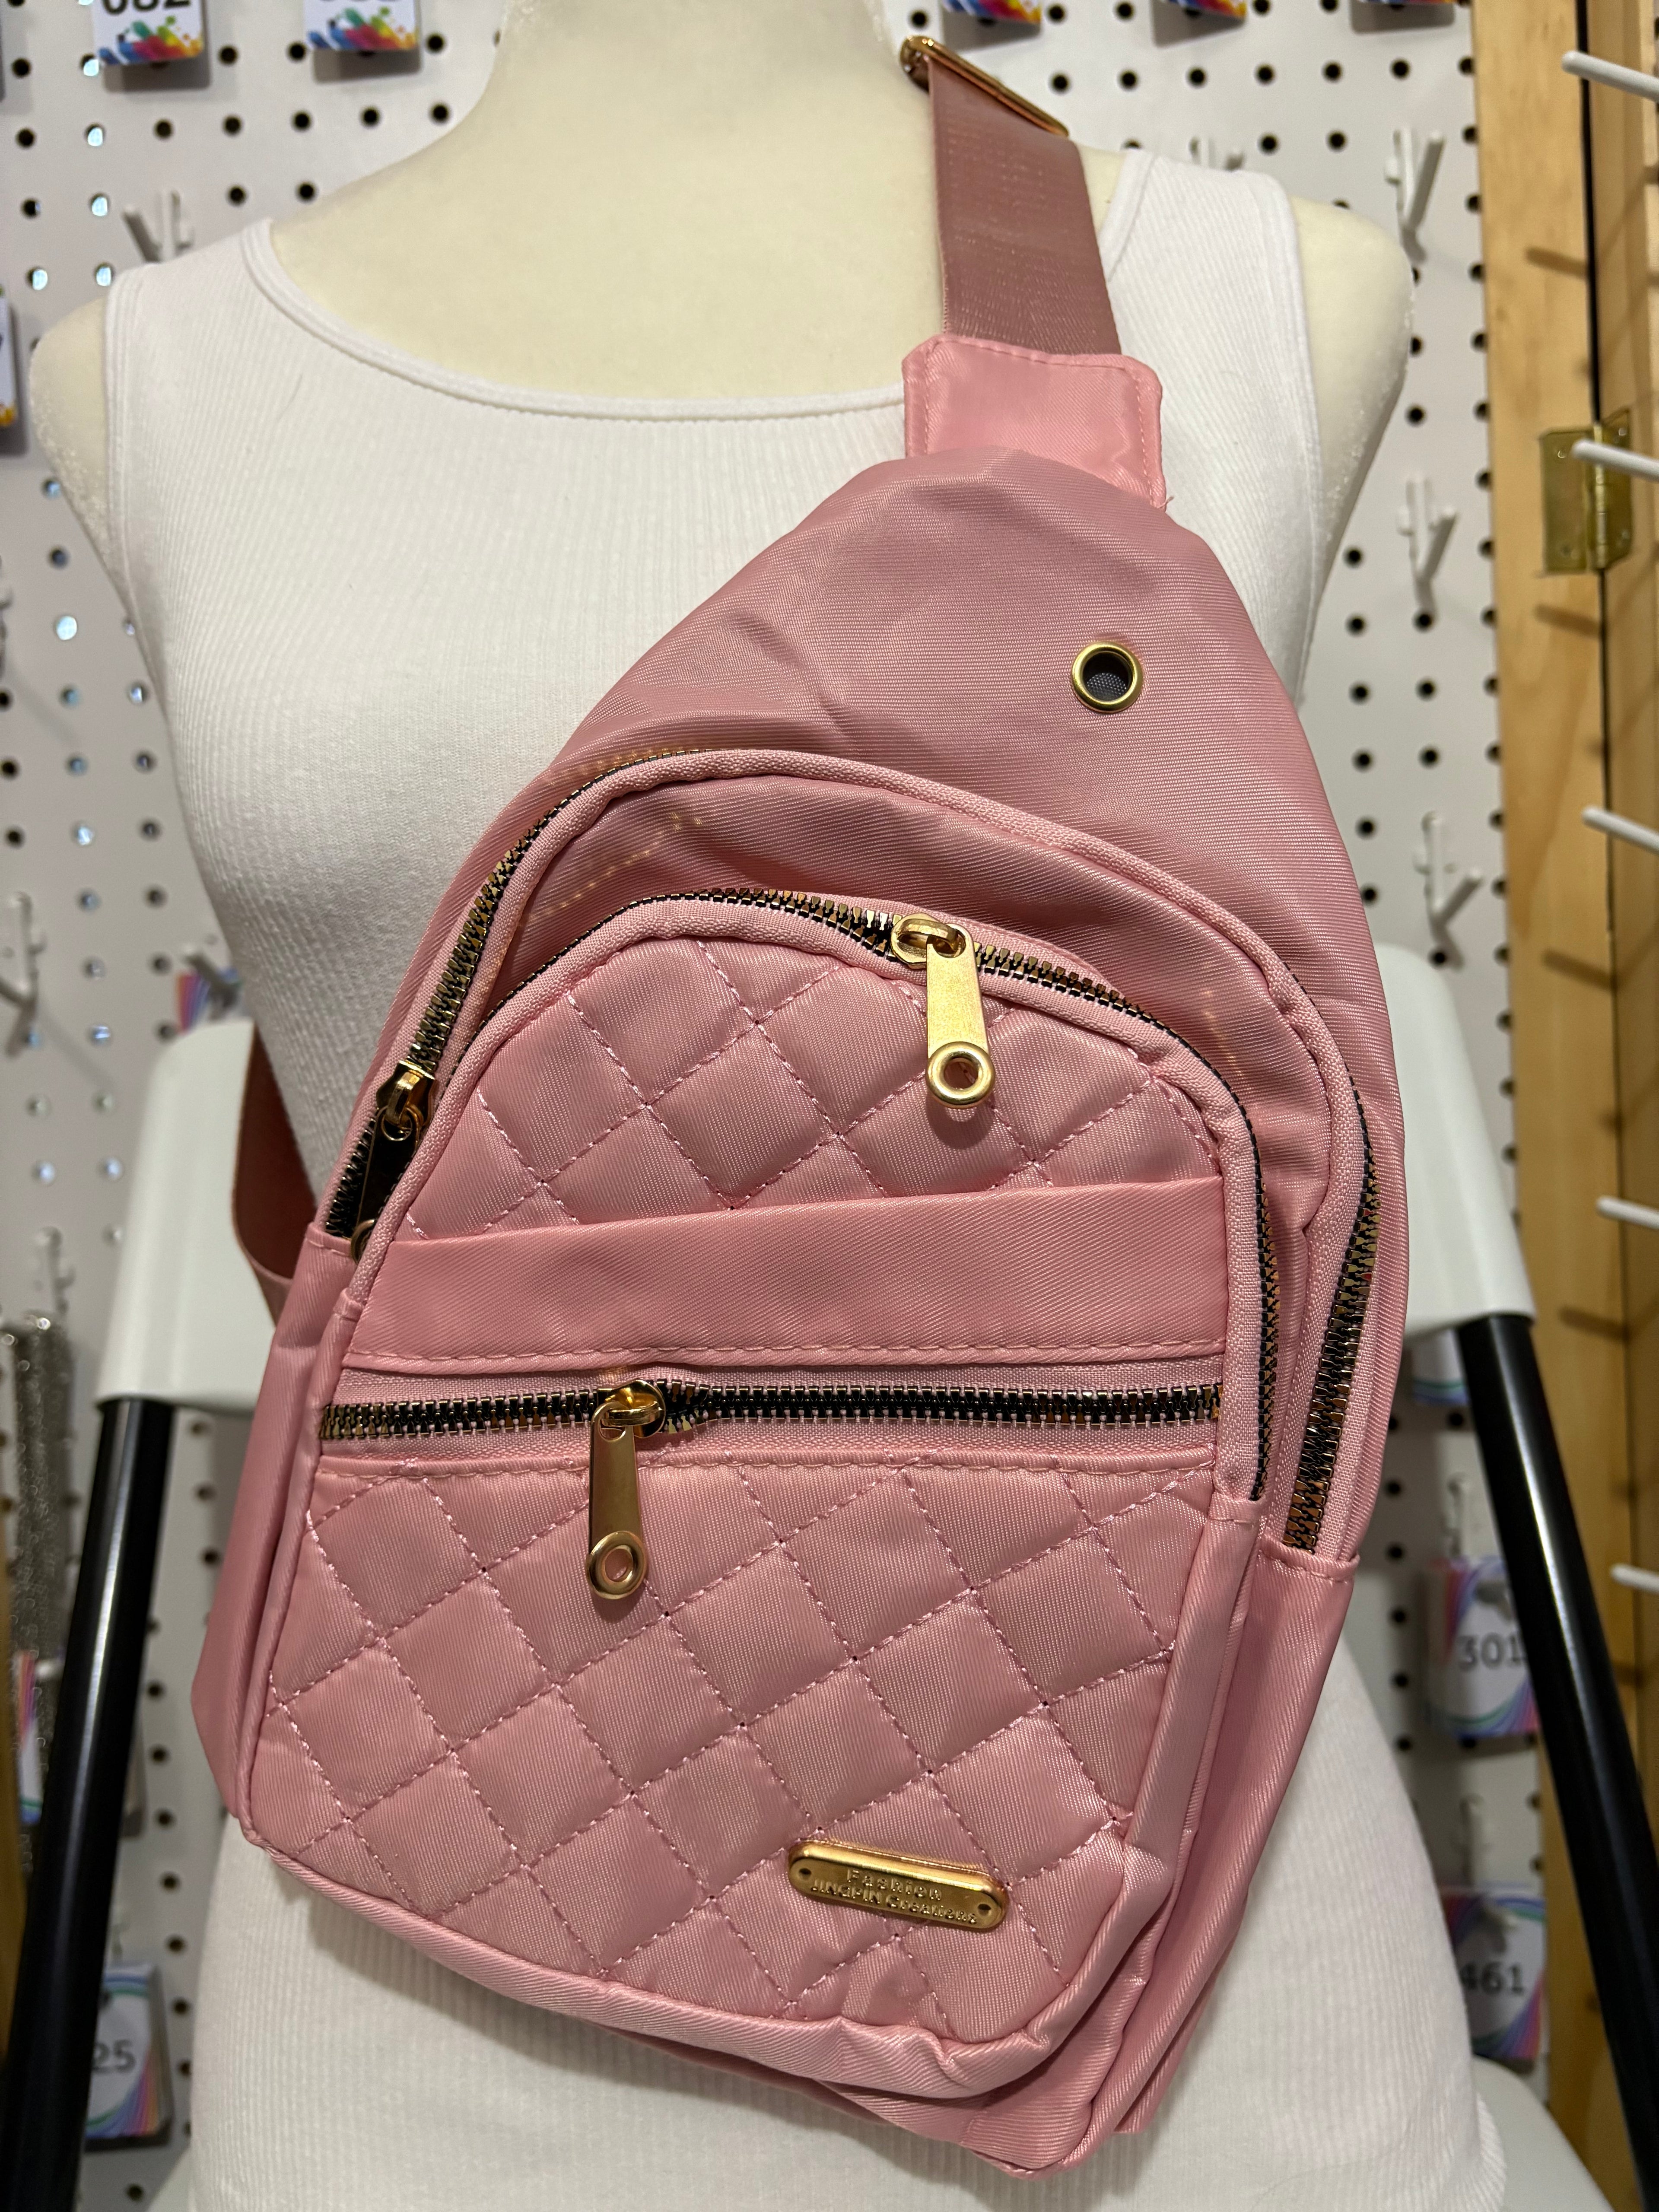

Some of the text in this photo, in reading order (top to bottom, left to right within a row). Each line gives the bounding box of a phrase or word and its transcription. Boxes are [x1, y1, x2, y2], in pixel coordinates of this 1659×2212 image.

[1458, 1632, 1522, 1672] 301
[846, 1869, 942, 1901] Fashion
[885, 1894, 977, 1924] Creations
